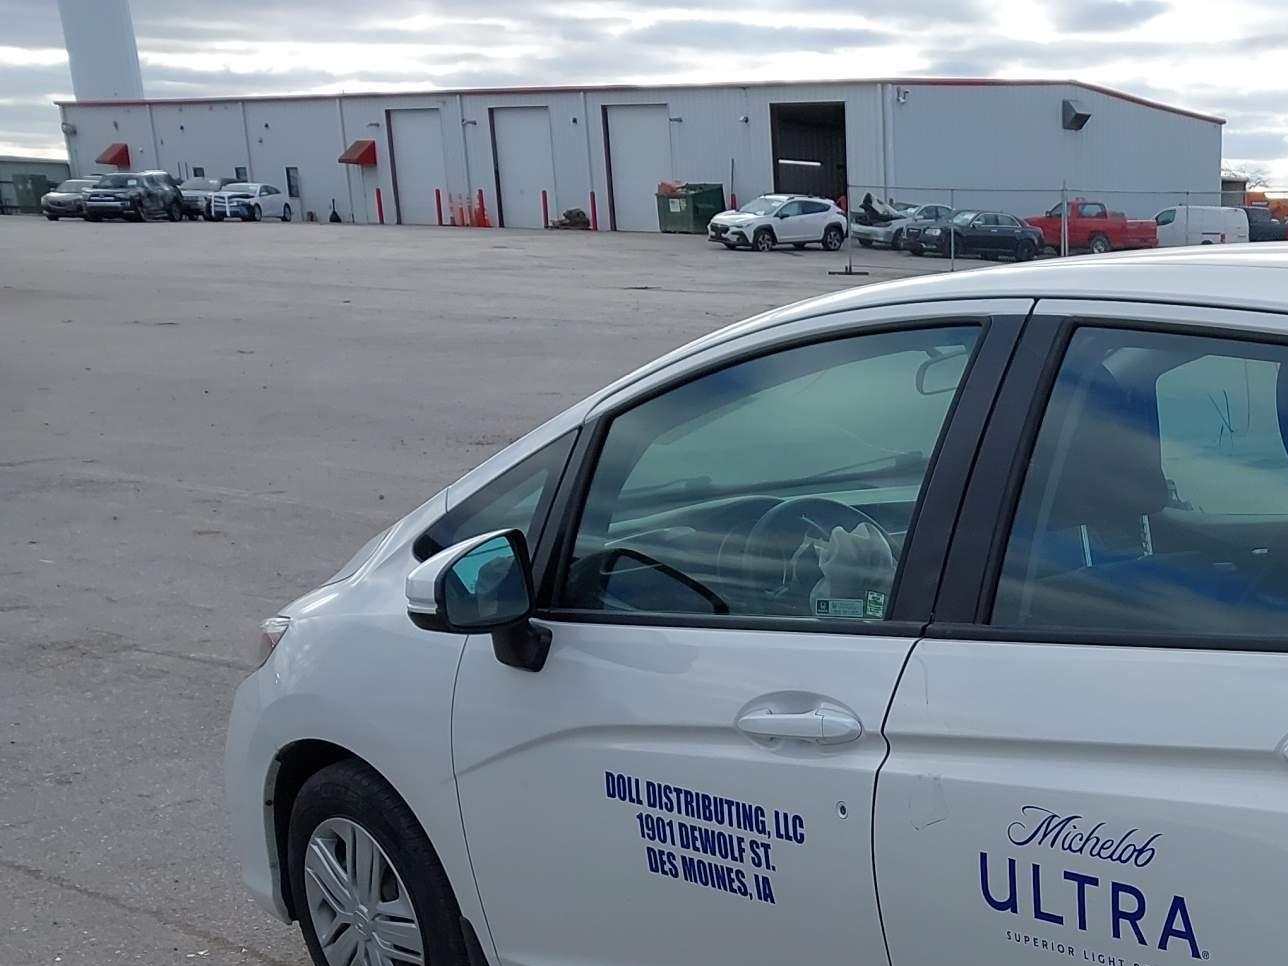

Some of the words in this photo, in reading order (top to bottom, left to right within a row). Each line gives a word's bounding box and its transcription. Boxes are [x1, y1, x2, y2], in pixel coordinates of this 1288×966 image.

[605, 771, 643, 806] DOLL
[646, 781, 772, 840] DISTRIBUTING,
[774, 810, 805, 844] LLC
[1007, 805, 1163, 868] Michelob
[636, 812, 676, 846] 1901
[678, 822, 745, 864] DEWOLF
[749, 840, 776, 871] ST.
[646, 846, 680, 879] DES
[681, 855, 753, 900] MOINES,
[754, 874, 776, 904] IA
[979, 851, 1202, 960] ULTRA
[1006, 931, 1075, 957] SUPERIOR
